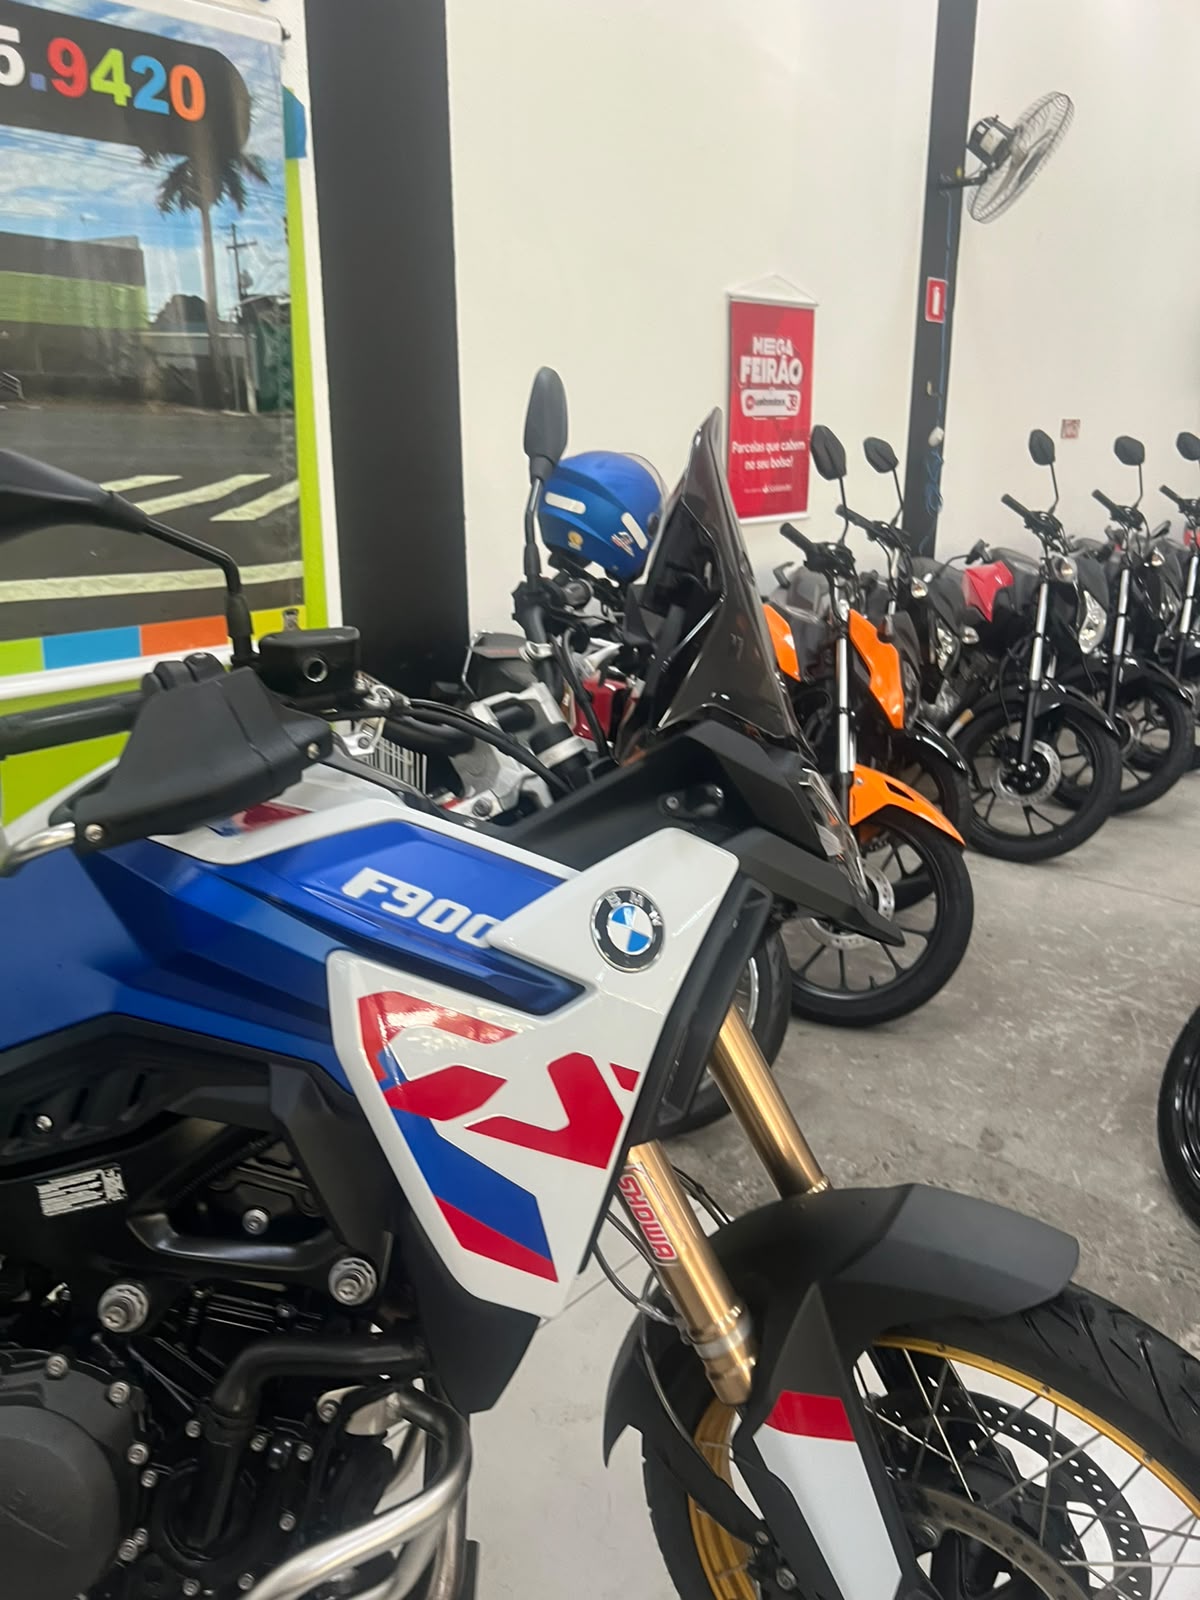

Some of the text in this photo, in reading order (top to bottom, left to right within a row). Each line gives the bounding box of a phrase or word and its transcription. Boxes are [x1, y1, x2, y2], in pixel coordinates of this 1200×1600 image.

[752, 336, 794, 357] MEGA
[740, 354, 803, 386] FEIRÃO
[732, 438, 806, 455] Parcelas que cabem
[744, 460, 756, 471] no
[756, 459, 770, 471] seu
[341, 867, 500, 948] F900
[617, 1174, 678, 1261] SHOWA
